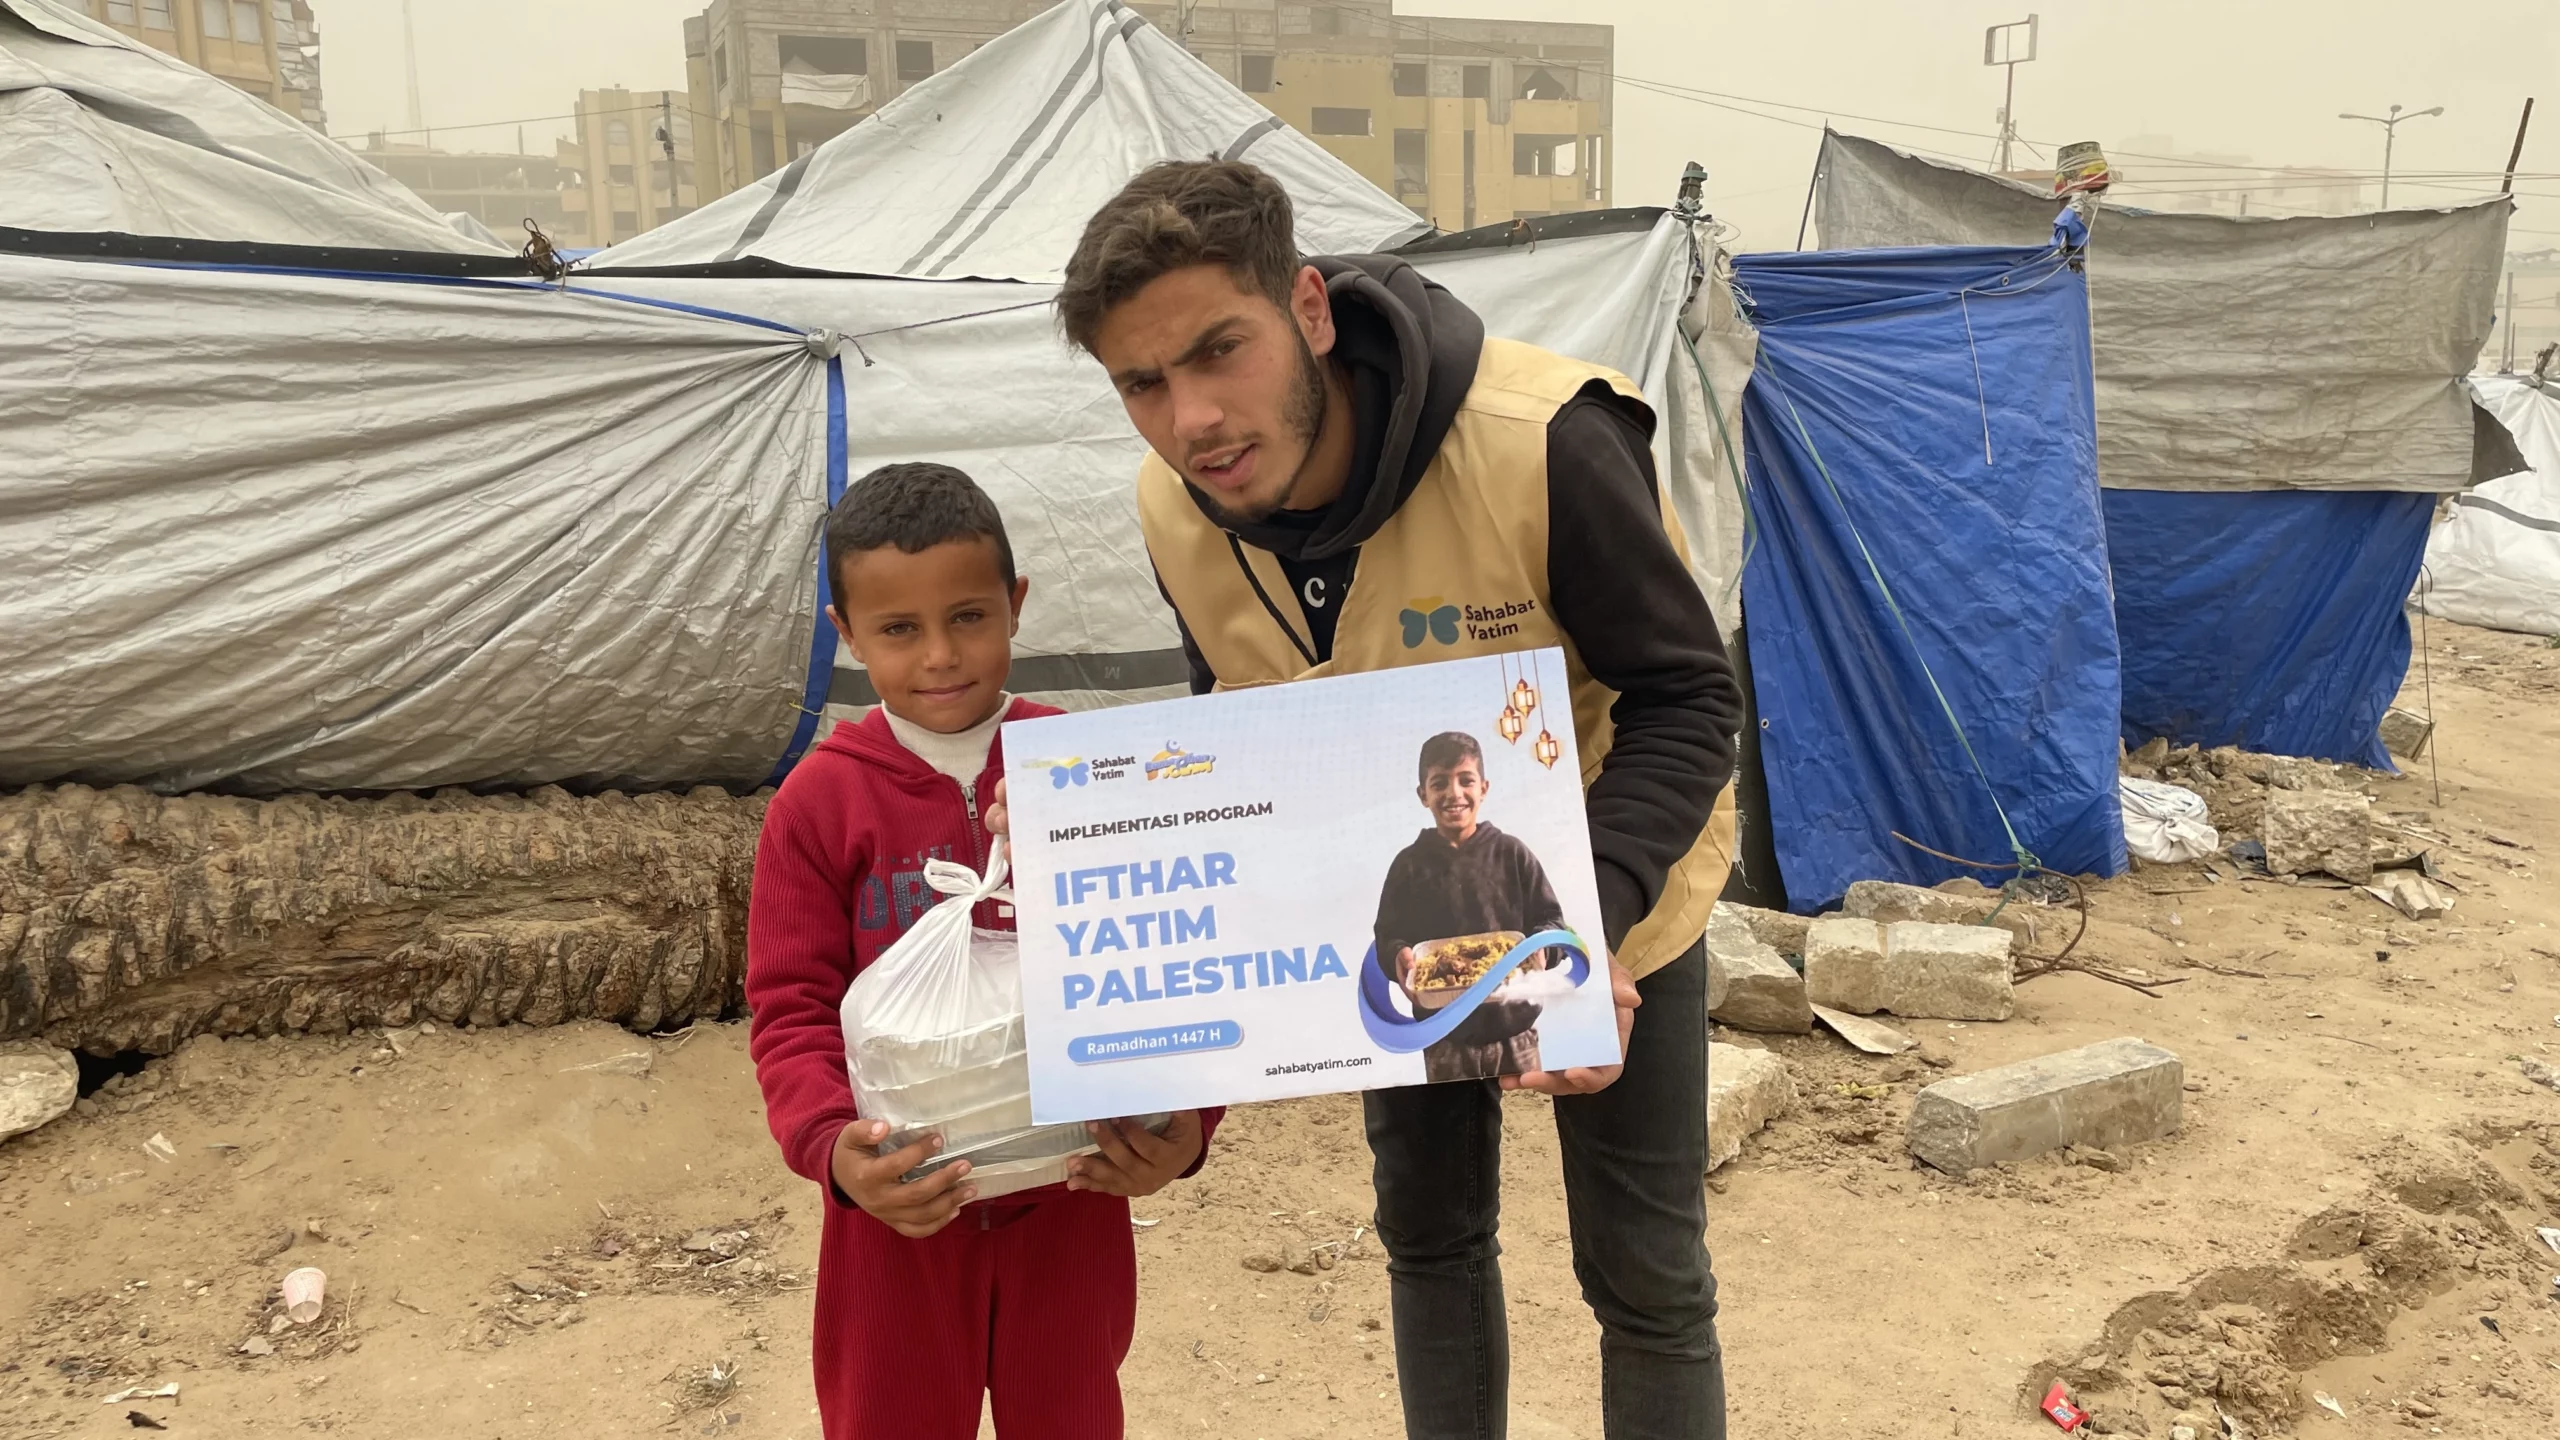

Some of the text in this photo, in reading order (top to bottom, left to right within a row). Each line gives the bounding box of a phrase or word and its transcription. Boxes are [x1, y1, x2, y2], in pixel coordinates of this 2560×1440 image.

[1464, 599, 1536, 622] Sahabat
[1466, 622, 1519, 641] Yatim
[1091, 756, 1136, 770] Sahabat
[1092, 768, 1124, 781] Yatim
[1049, 801, 1273, 843] IMPLEMENTASI PROGRAM
[1054, 852, 1237, 907] IFTHAR
[1056, 904, 1218, 957] YATIM
[1063, 943, 1350, 1010] PALESTINA
[1087, 1028, 1221, 1056] Ramadhan 1447 H
[1265, 1057, 1372, 1076] sahabatyatim.com
